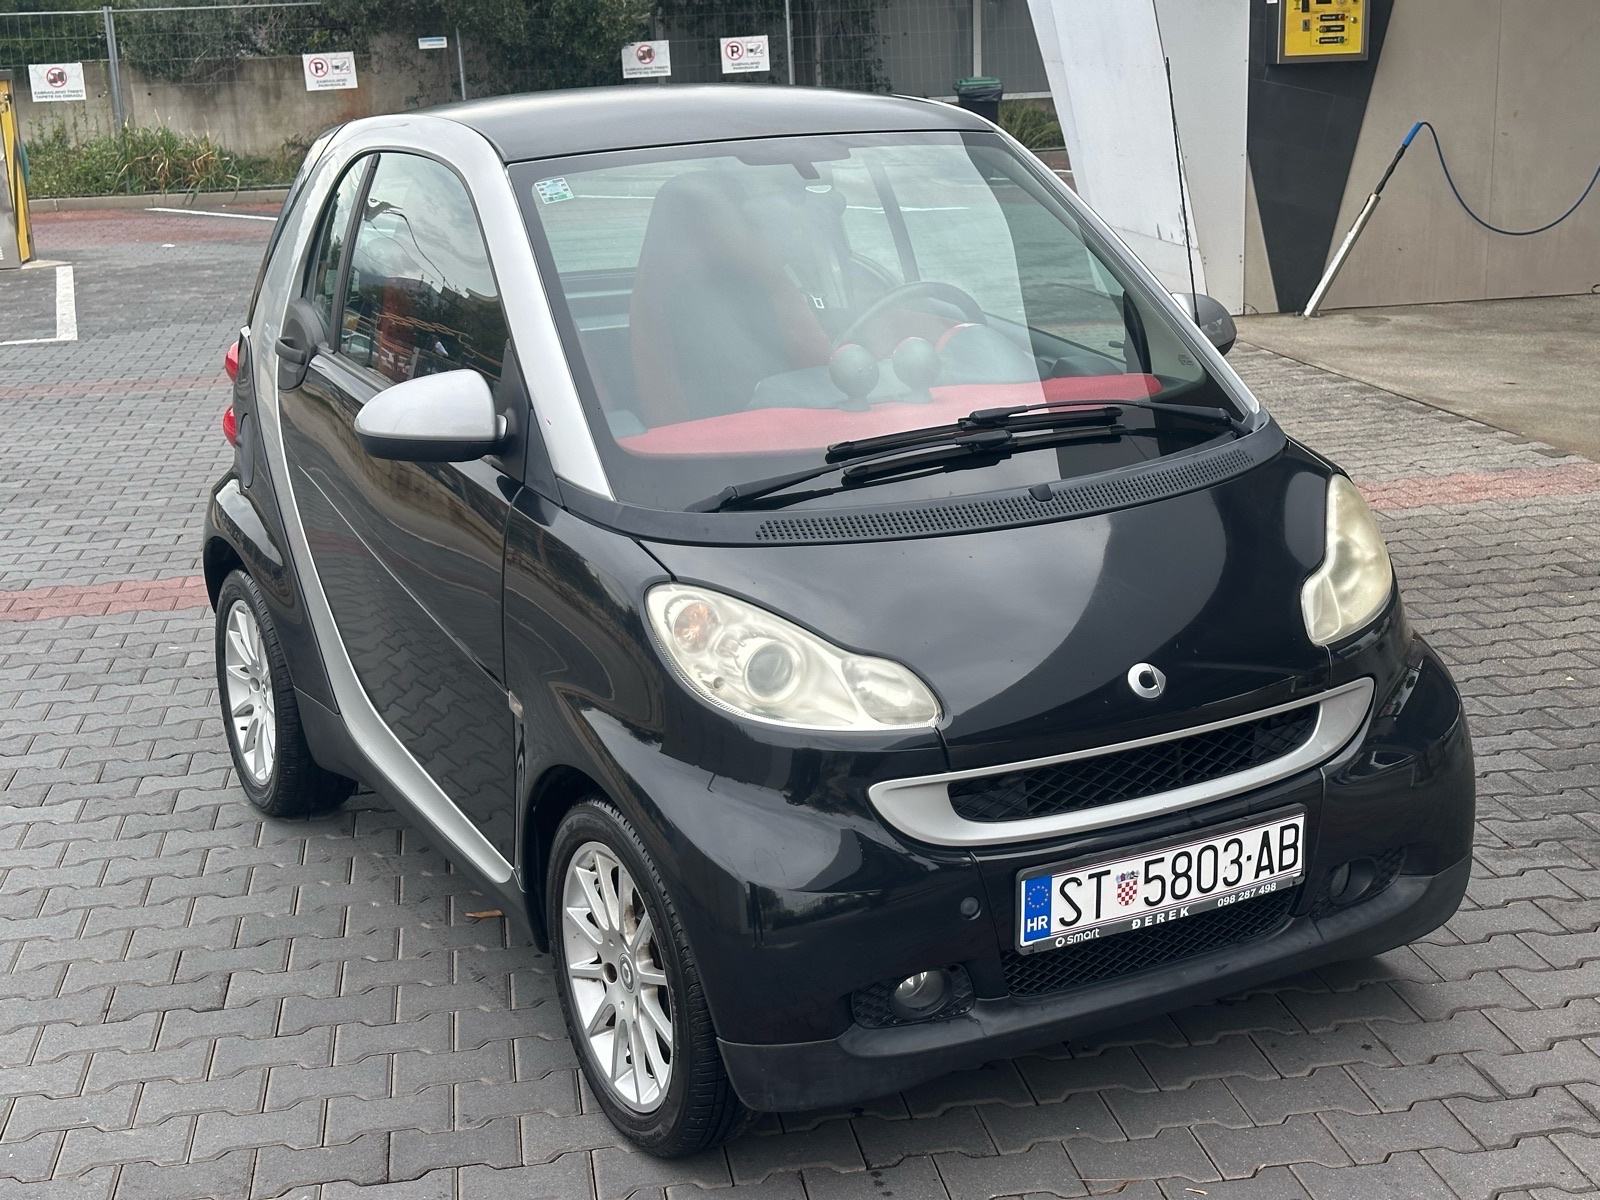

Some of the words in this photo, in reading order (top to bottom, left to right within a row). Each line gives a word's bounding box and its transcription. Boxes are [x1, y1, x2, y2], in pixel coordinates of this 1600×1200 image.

[1059, 869, 1111, 927] ST
[1217, 894, 1236, 907] 098
[1238, 888, 1257, 902] 287
[1258, 882, 1277, 895] 498
[1026, 915, 1048, 933] HR
[1066, 928, 1100, 944] smart
